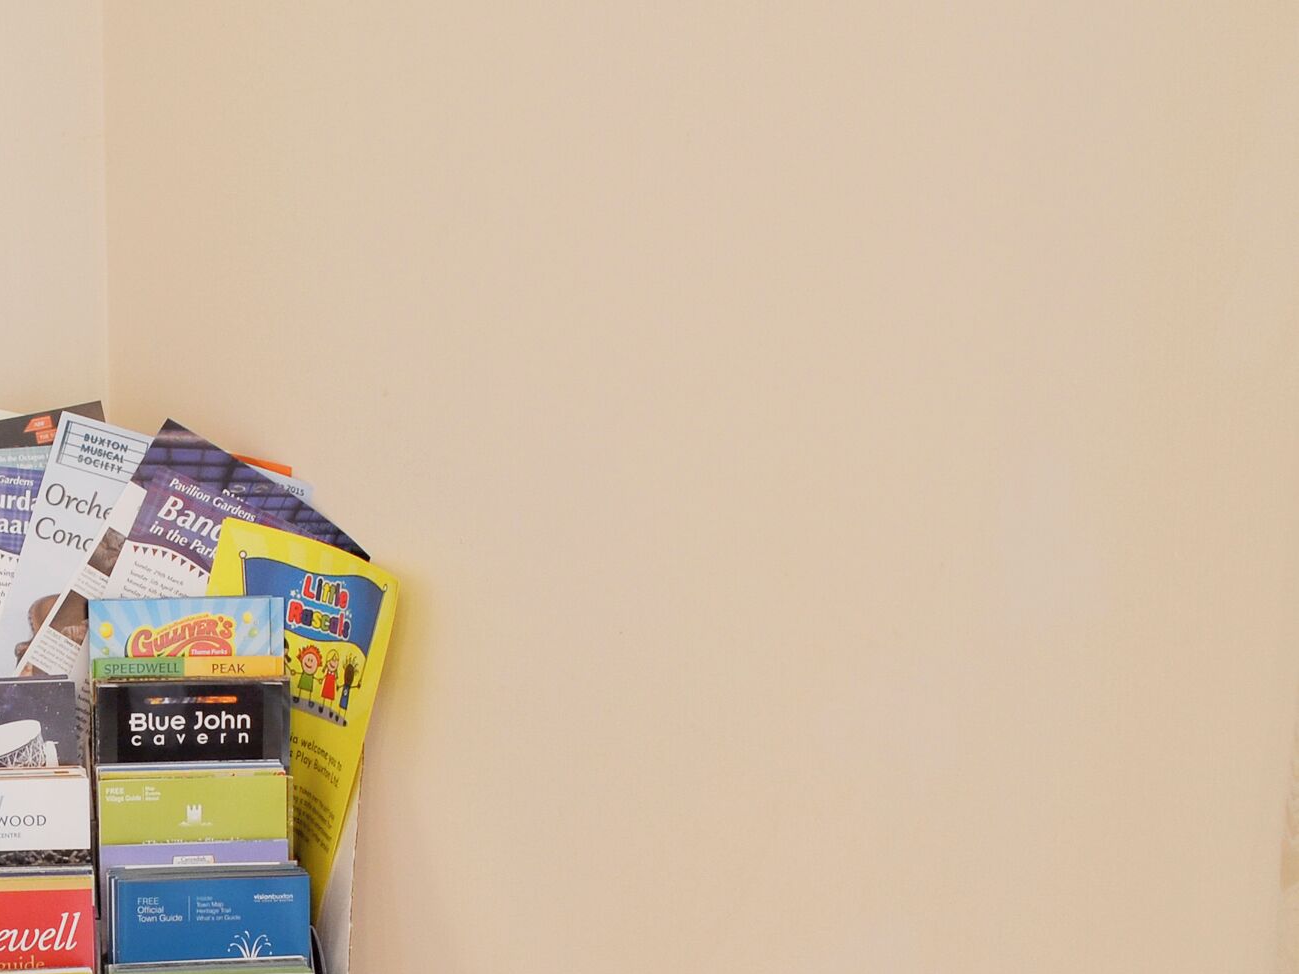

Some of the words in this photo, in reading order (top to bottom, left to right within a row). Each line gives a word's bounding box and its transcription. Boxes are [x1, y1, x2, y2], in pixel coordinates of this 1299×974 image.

[83, 433, 129, 452] BUXTON
[80, 444, 125, 463] MUSICAL
[78, 454, 123, 473] SOCIETY
[170, 478, 210, 504] Pavilion
[212, 496, 257, 522] Gardens
[285, 484, 305, 497] 2015
[149, 521, 164, 538] in
[167, 529, 189, 547] the
[302, 574, 349, 610] Little
[286, 599, 350, 640] Rascals
[103, 661, 180, 675] SPEEDWELL
[211, 662, 245, 674] PEAK
[128, 712, 186, 732] Blue
[194, 711, 252, 731] John
[131, 730, 250, 747] cavern
[296, 750, 312, 768] Play
[301, 739, 328, 760] welcome
[137, 897, 159, 905] FREE
[137, 906, 164, 914] Official
[137, 915, 158, 923] Town
[159, 914, 183, 923] Guide
